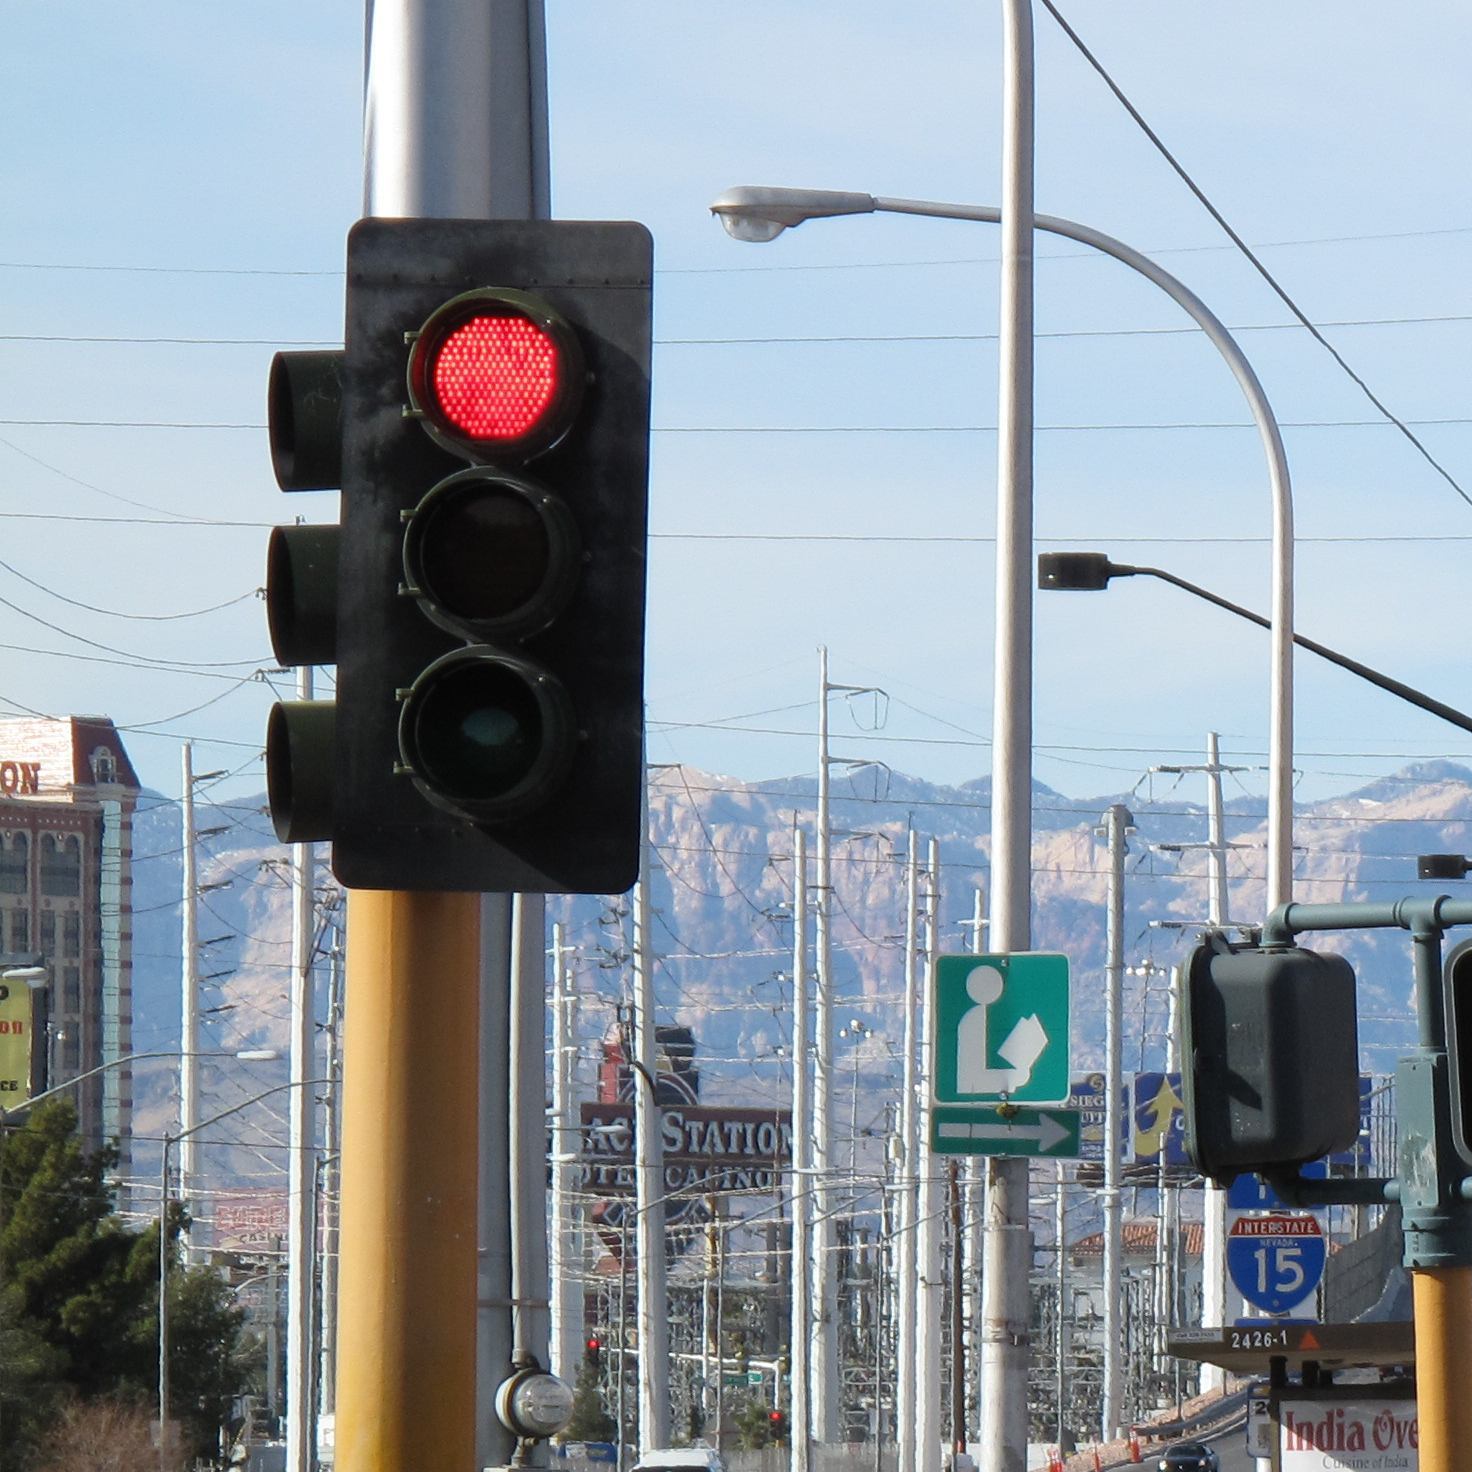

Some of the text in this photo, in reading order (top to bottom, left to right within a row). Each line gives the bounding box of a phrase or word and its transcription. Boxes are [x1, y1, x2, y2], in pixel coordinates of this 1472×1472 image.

[1238, 1221, 1315, 1234] INTERSTATE
[1254, 1248, 1305, 1293] 15
[1231, 1330, 1288, 1349] 2426-1
[1285, 1408, 1366, 1451] India
[1322, 1454, 1369, 1469] Cuisine
[1384, 1454, 1409, 1468] India
